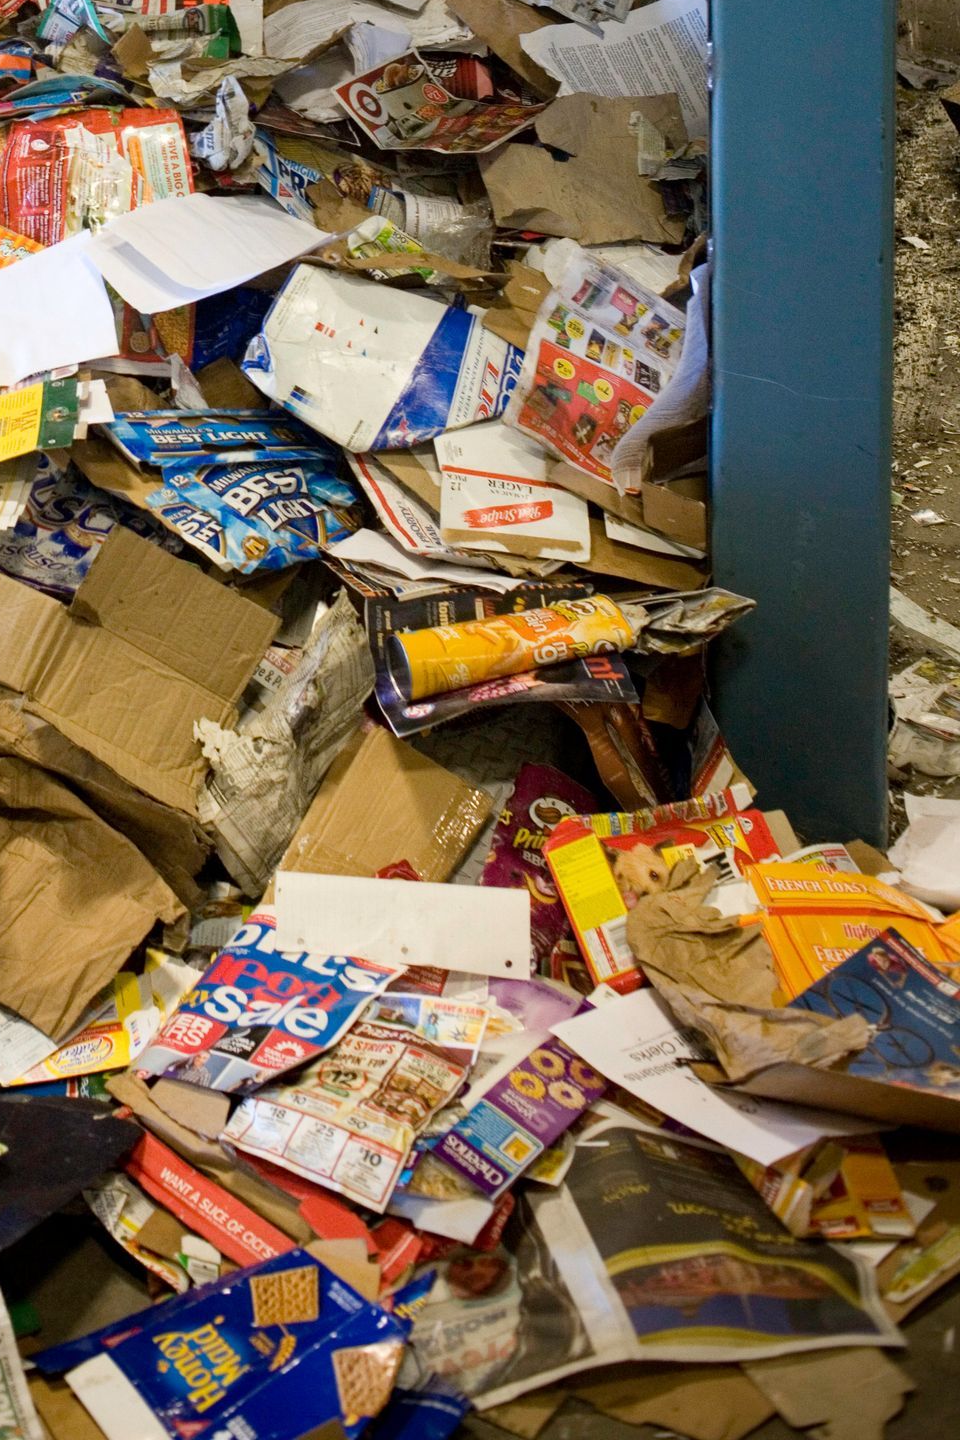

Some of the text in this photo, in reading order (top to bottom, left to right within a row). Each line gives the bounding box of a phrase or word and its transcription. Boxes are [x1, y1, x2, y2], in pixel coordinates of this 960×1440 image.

[168, 137, 180, 161] GIVE
[172, 171, 184, 190] BIG
[145, 427, 205, 437] MILWAUKEE'S
[153, 430, 269, 445] BEST LIGHT
[168, 474, 189, 488] 12
[450, 481, 462, 491] 12
[487, 479, 533, 494] LAGER
[220, 466, 310, 517] BEST
[400, 505, 431, 544] PRIORITY
[479, 506, 541, 524] Red Stripe
[424, 524, 443, 546] MAIL
[766, 877, 824, 894] FRENCH
[204, 985, 329, 1039] Sale
[630, 1042, 678, 1062] Clerks
[359, 1148, 381, 1167] $10
[447, 1133, 505, 1187] Cheerios
[160, 1167, 193, 1194] WANT
[198, 1195, 228, 1225] SLICE
[225, 1217, 246, 1235] OF
[188, 1322, 251, 1388] Maid
[151, 1330, 227, 1414] Honey
